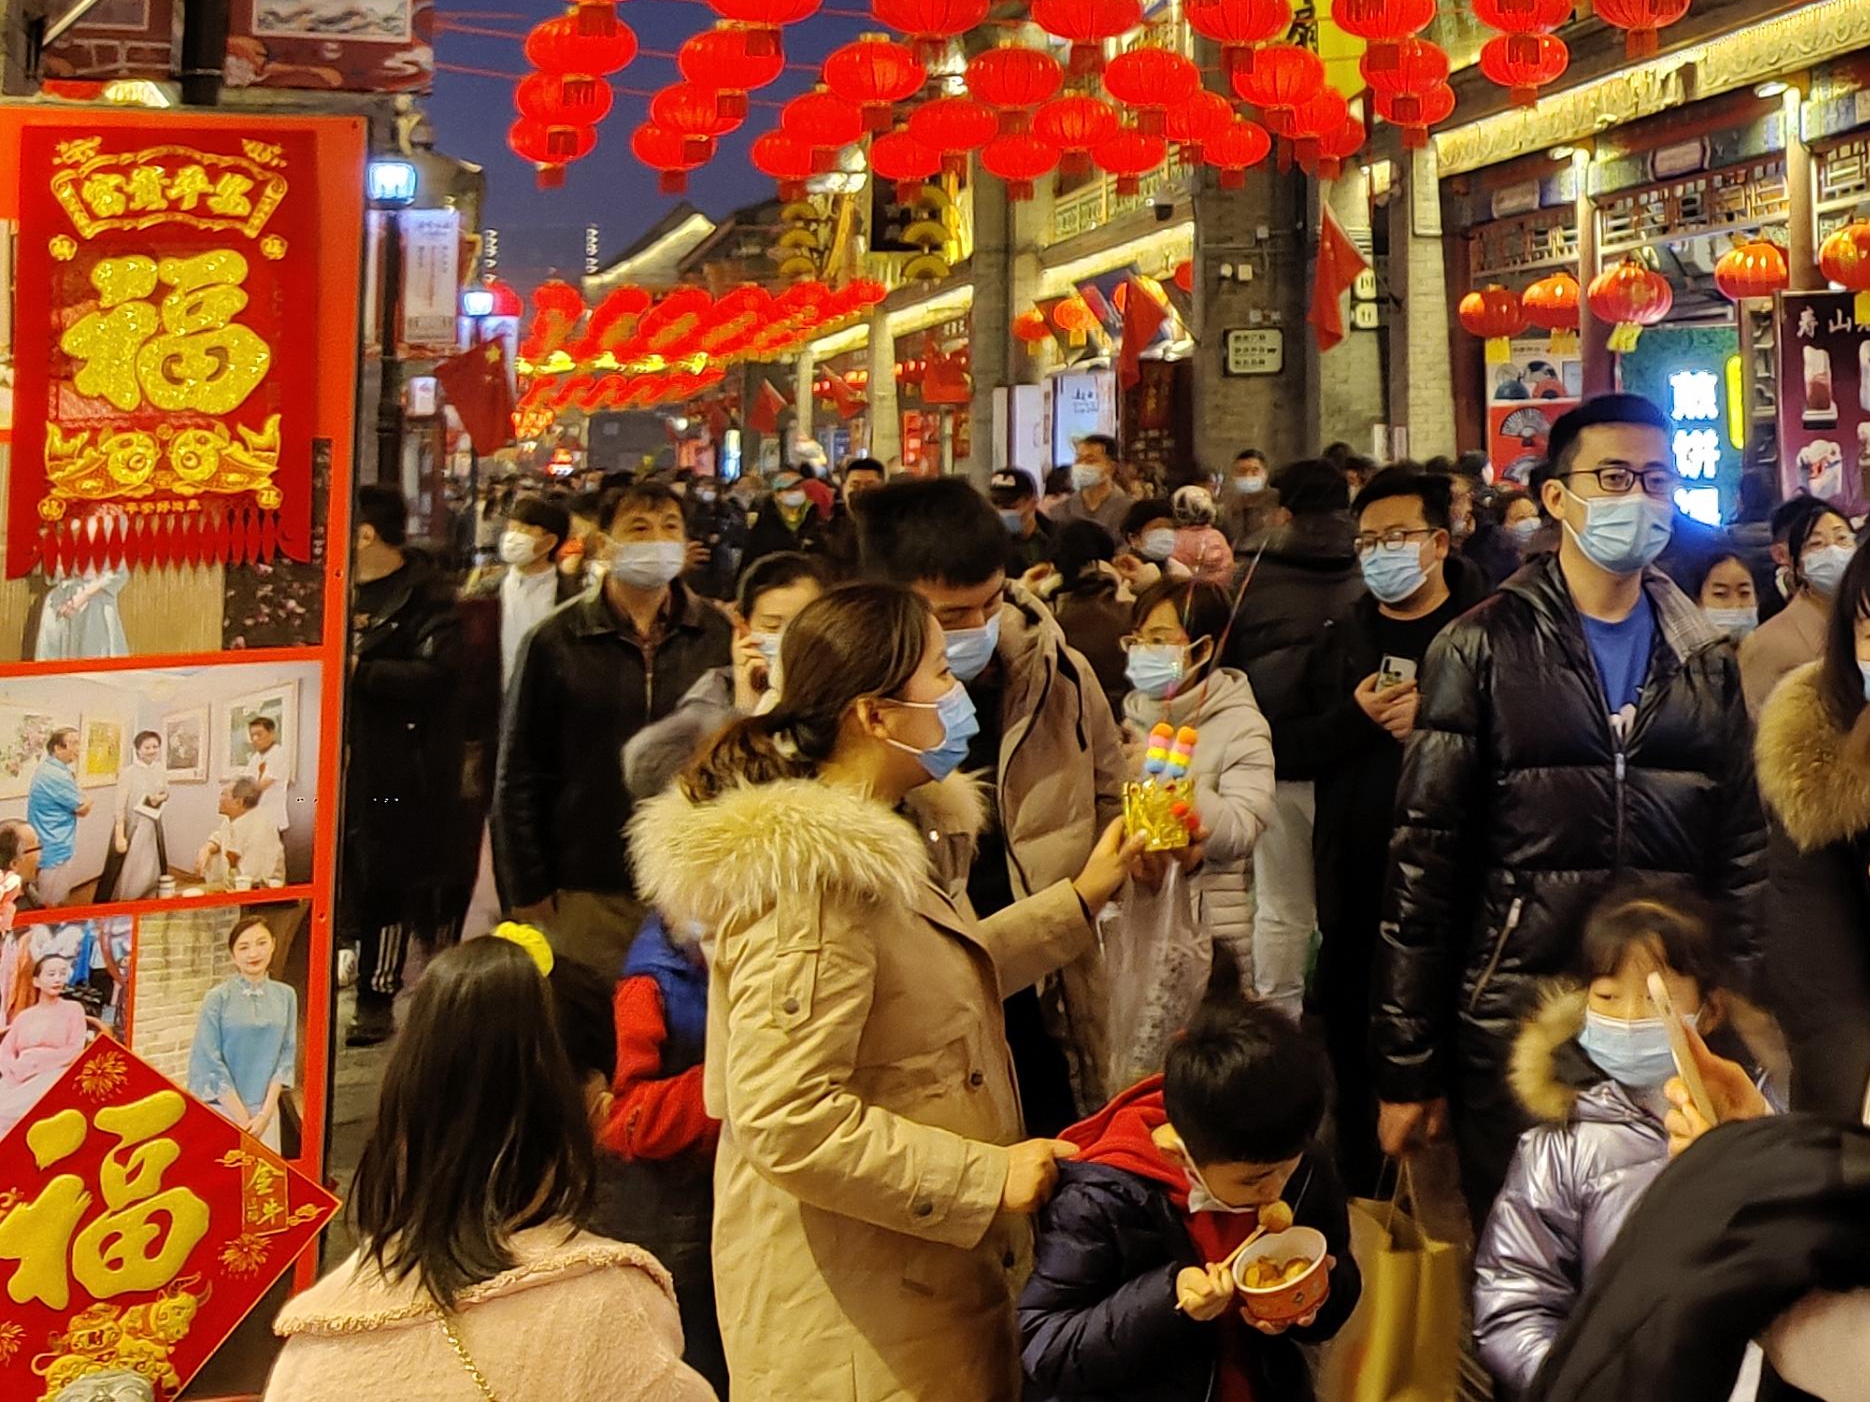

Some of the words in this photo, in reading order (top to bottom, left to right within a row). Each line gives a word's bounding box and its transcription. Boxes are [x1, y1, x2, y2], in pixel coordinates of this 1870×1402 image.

[59, 249, 272, 415] 福
[0, 1090, 210, 1310] 福
[246, 1157, 286, 1226] 金牛
